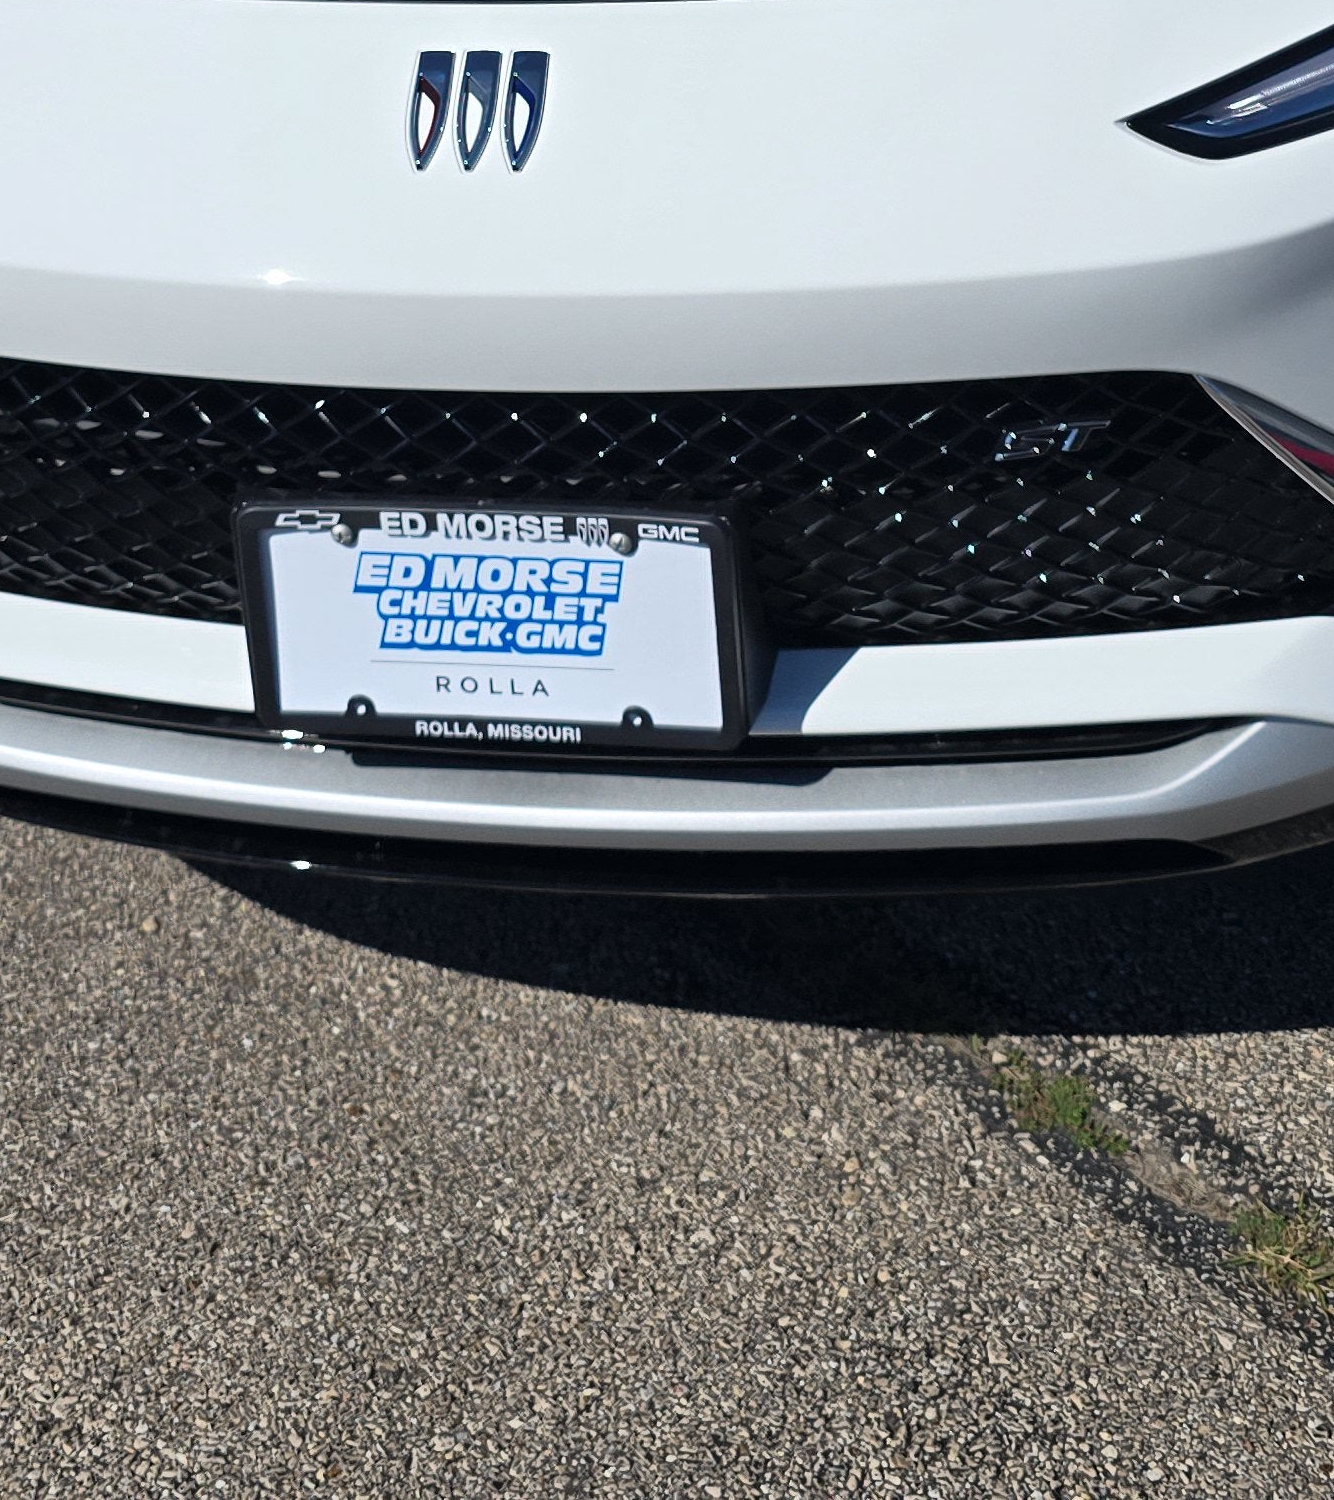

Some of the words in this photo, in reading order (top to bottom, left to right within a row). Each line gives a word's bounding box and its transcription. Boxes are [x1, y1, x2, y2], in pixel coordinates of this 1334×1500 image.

[379, 511, 427, 536] ED
[436, 513, 565, 542] MORSE
[637, 523, 700, 543] GMC
[356, 552, 427, 588] ED
[430, 555, 621, 595] MORSE
[436, 675, 550, 697] ROLLA
[415, 720, 484, 740] ROLLA,
[487, 722, 582, 744] MISSOURI
